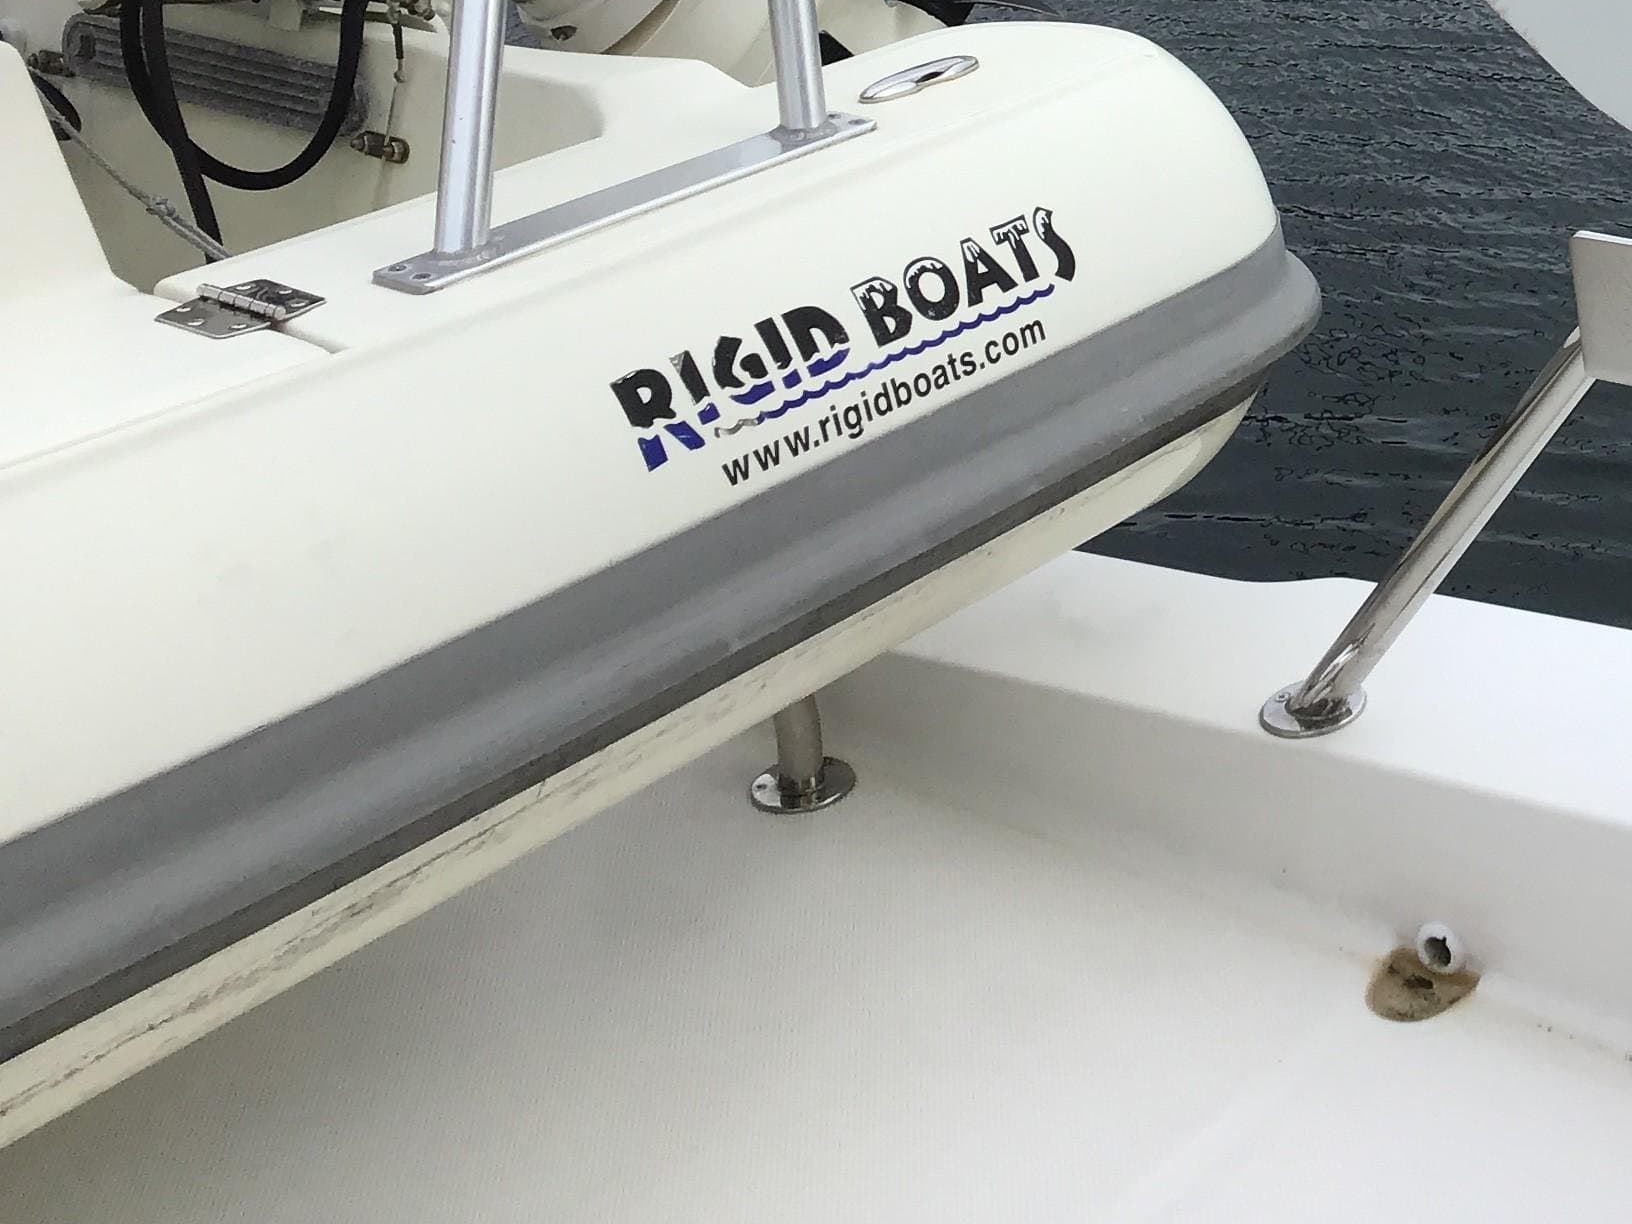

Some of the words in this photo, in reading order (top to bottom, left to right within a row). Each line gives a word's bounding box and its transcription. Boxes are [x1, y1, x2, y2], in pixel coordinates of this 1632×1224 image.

[609, 306, 851, 472] RIGID
[850, 207, 1077, 347] BOATS
[721, 316, 1047, 486] www.rigidboats.com
